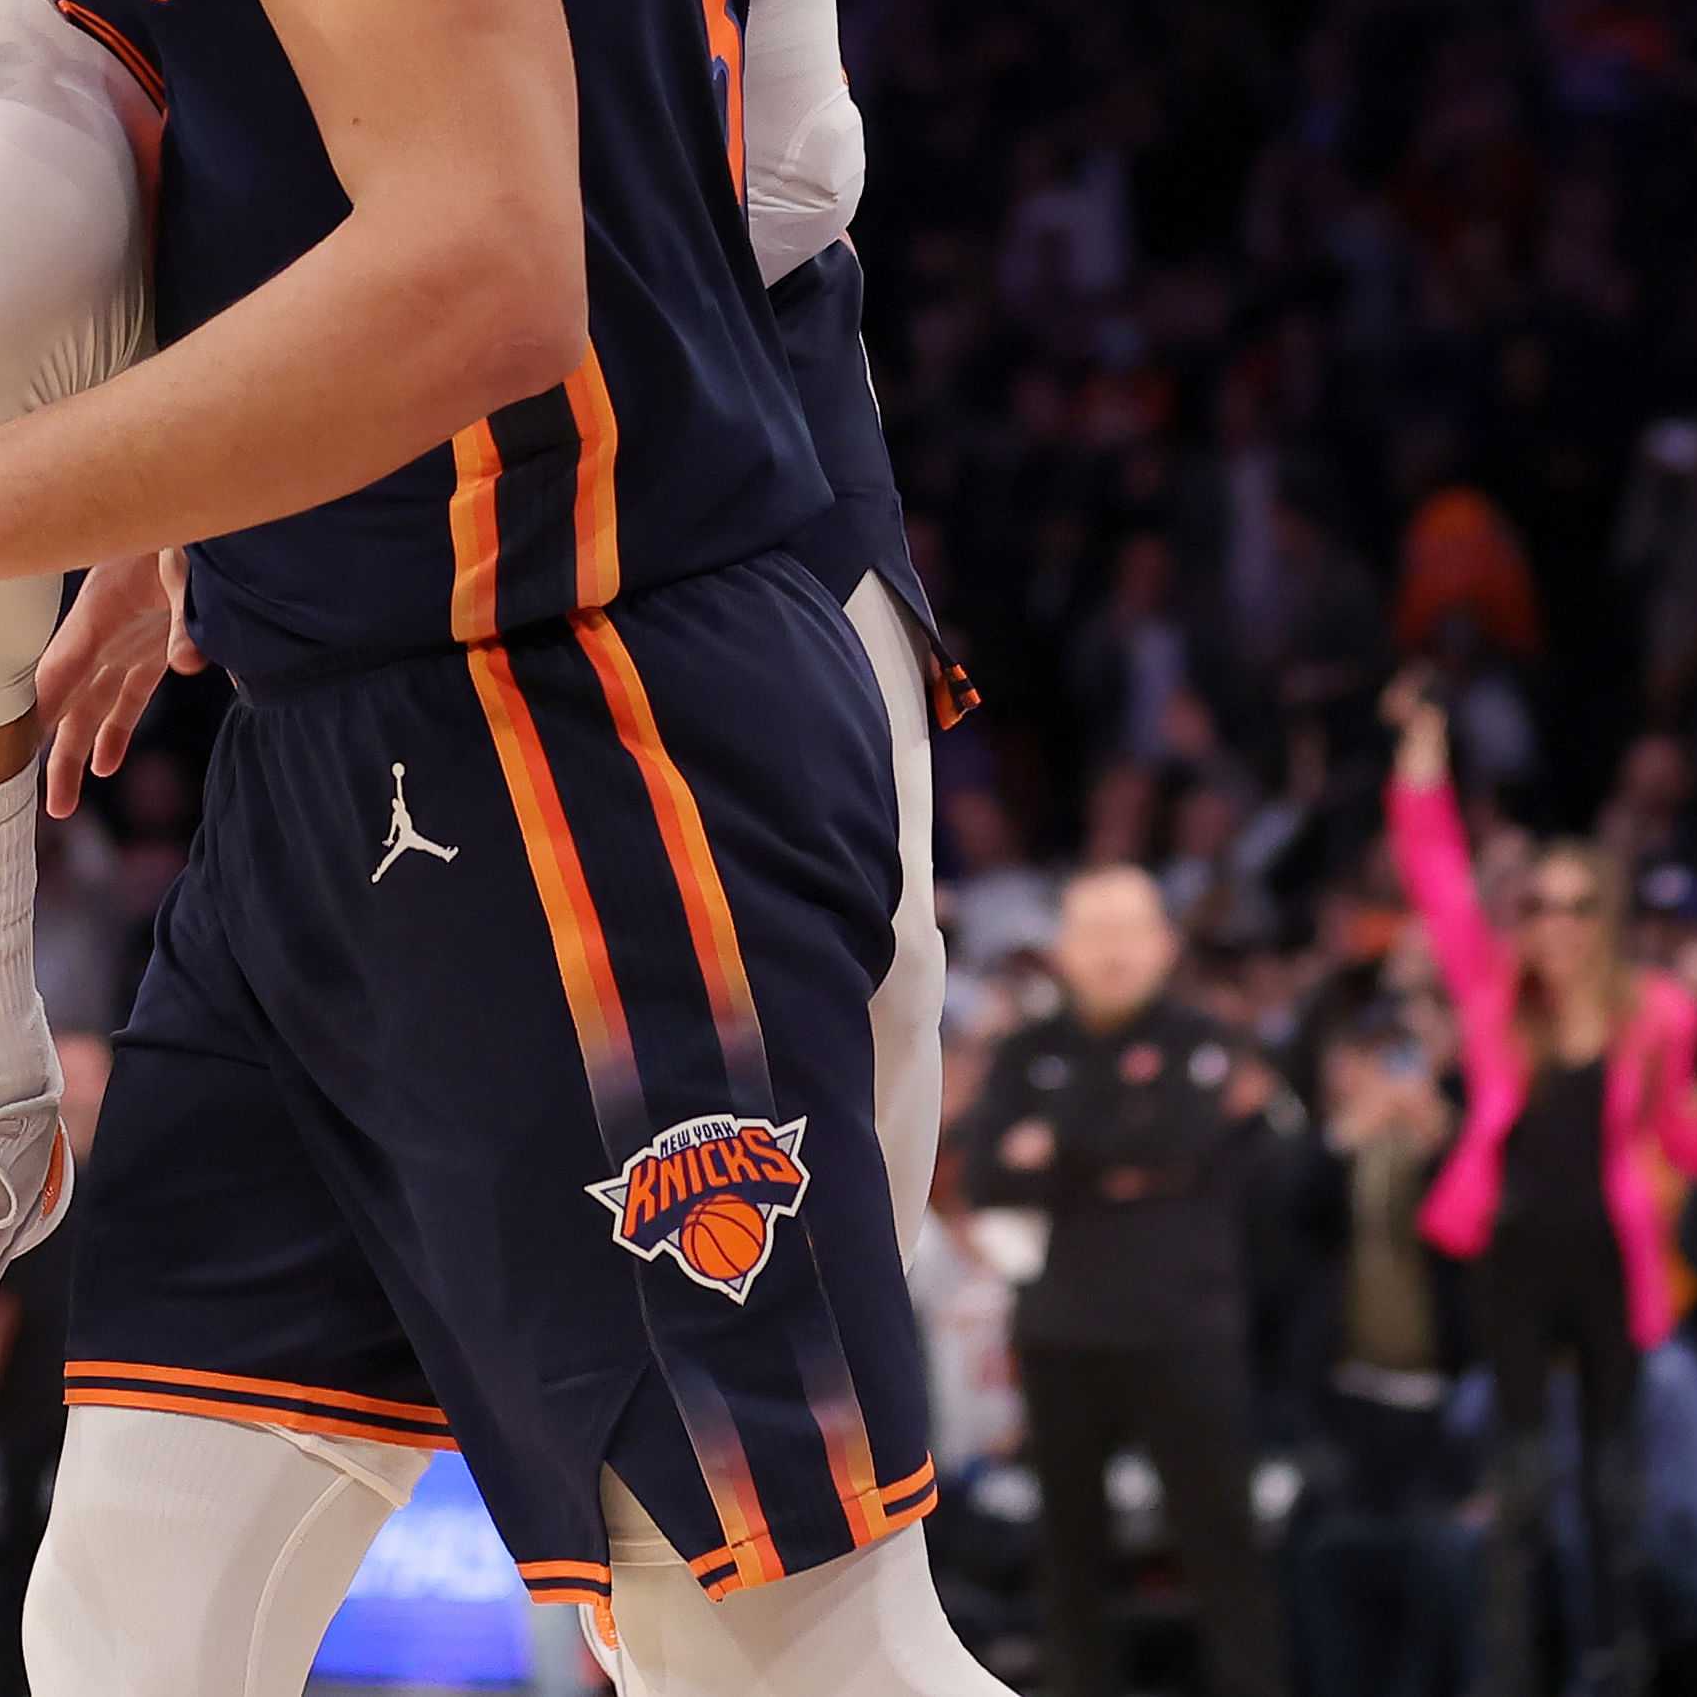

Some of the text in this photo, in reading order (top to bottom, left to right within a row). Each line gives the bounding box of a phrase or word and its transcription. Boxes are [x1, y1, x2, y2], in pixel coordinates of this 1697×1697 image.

[660, 1120, 736, 1159] NEW YORK
[622, 1126, 804, 1239] KNICKS
